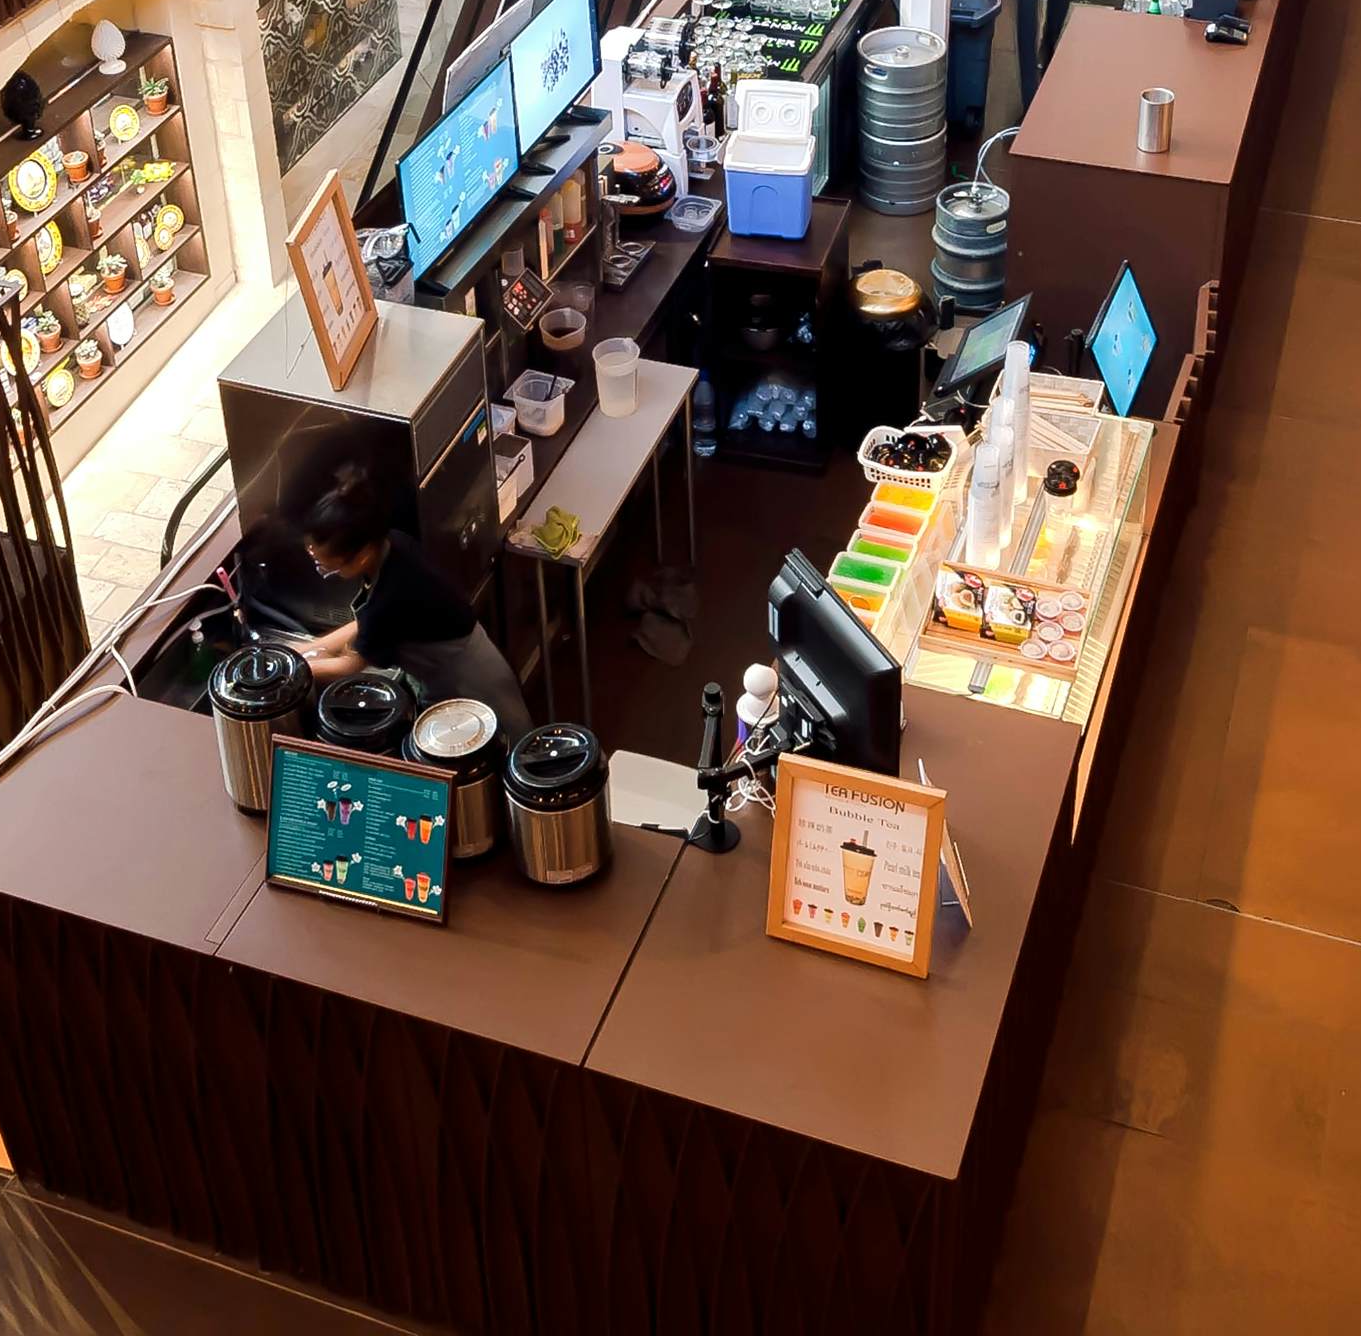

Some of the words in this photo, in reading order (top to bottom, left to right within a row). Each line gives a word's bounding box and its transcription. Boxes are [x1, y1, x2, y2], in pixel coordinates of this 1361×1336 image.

[851, 791, 906, 815] FUSION
[829, 806, 874, 823] Bubble
[880, 818, 900, 831] Tea
